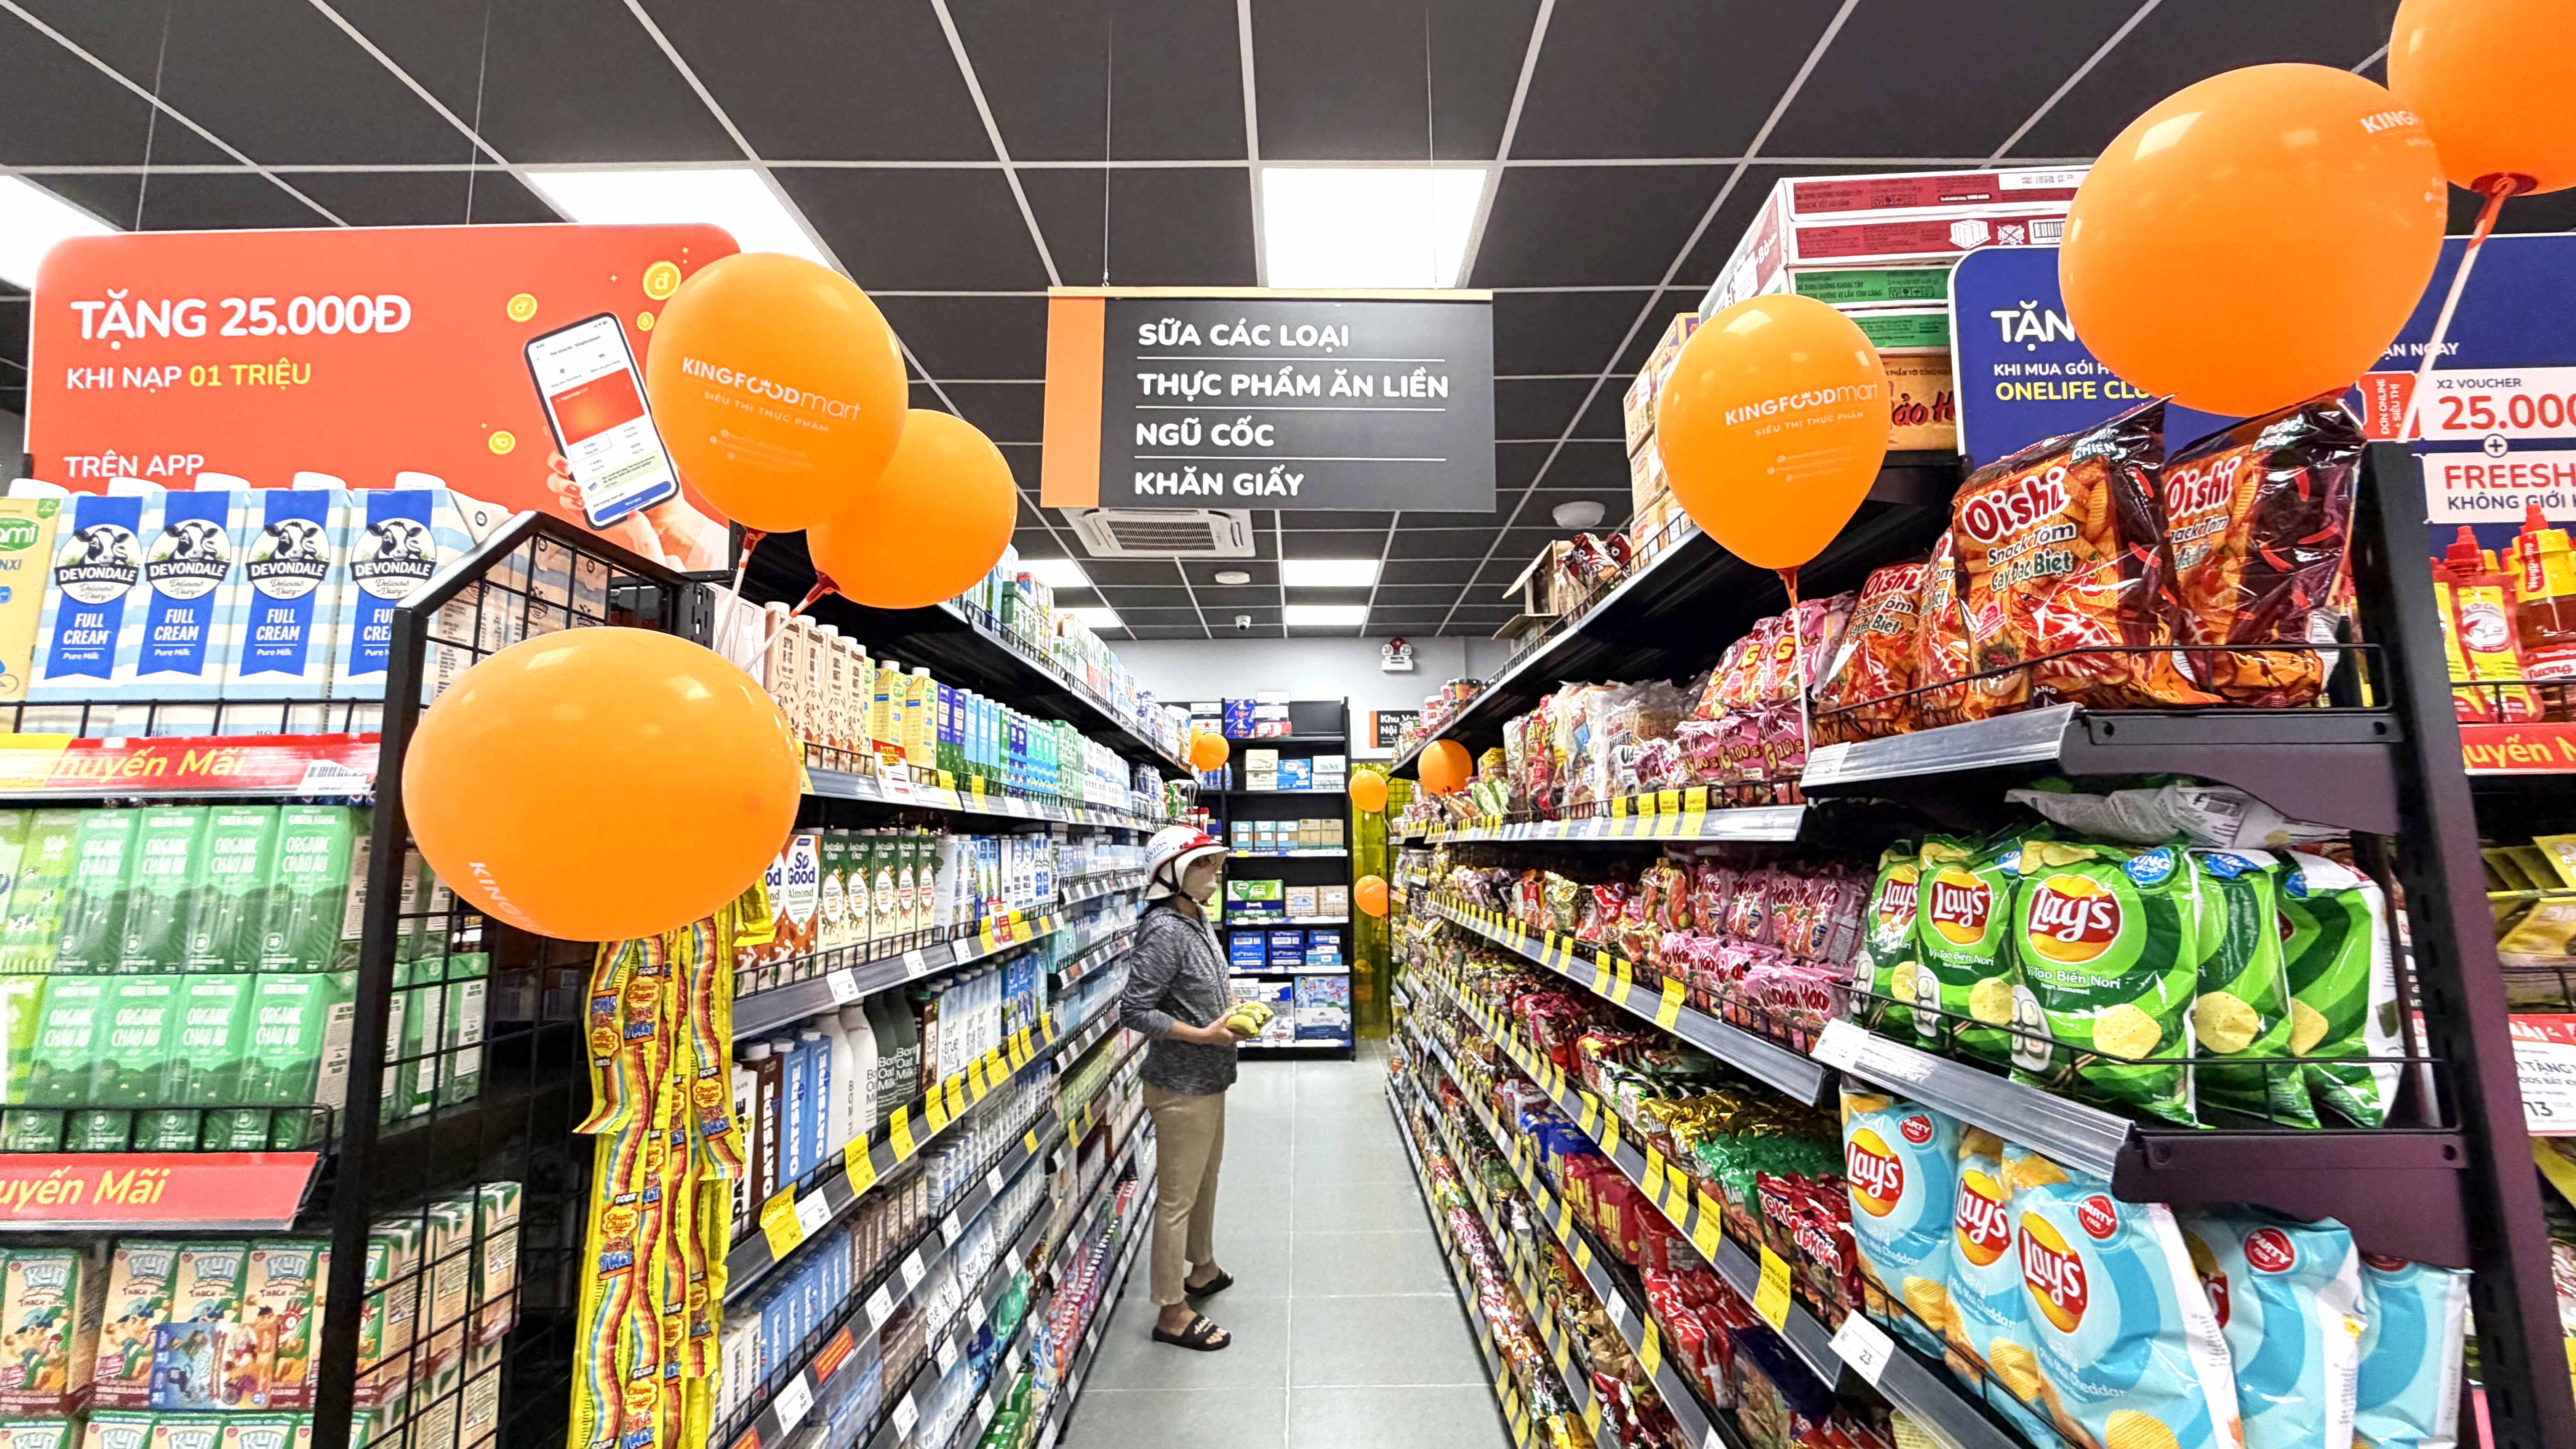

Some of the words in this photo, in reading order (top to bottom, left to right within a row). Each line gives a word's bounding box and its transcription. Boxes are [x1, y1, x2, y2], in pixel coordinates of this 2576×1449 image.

[70, 288, 207, 350] TẶNG
[220, 295, 411, 338] 25.000Đ
[1990, 300, 2076, 351] TẶN
[1138, 317, 1201, 346] SỮA
[1210, 318, 1271, 346] CÁC
[1280, 324, 1349, 353] LOẠI
[66, 368, 113, 390] KHI
[122, 366, 182, 393] NẠP
[189, 364, 222, 386] 01
[230, 357, 311, 390] TRIỆU
[1994, 364, 2021, 376] KHI
[2025, 364, 2062, 376] MUA
[2065, 360, 2093, 375] GÓI
[1137, 370, 1222, 402] THỰC
[1231, 366, 1321, 398] PHẨM
[1329, 368, 1373, 398] ĂN
[1383, 367, 1448, 398] LIỀN
[1996, 381, 2097, 401] ONELIFE
[2436, 380, 2453, 389] X2
[2458, 378, 2522, 388] VOUCHER
[1136, 417, 1201, 445] NGŨ
[1211, 415, 1275, 447] CỐC
[64, 450, 138, 478] TRÊN
[146, 454, 204, 477] APP
[1135, 465, 1224, 495] KHĂN
[1233, 464, 1304, 496] GIẤY
[2164, 455, 2242, 521] Oishi
[1963, 467, 2070, 543] Oishi
[2447, 491, 2519, 510] KHÔNG
[2169, 523, 2203, 543] nack
[1988, 538, 2027, 568] Snack
[59, 568, 138, 582] DEVONDALE
[149, 563, 227, 578] DEVONDALE
[250, 563, 326, 577] DEVONDALE
[355, 562, 432, 576] DEVONDALE
[1991, 570, 2011, 593] Cay
[2033, 549, 2073, 578] Biệt
[74, 613, 104, 628] FULL
[165, 608, 194, 624] FULL
[266, 608, 295, 623] FULL
[63, 630, 109, 645] CREAM
[154, 625, 199, 641] CREAM
[256, 625, 301, 641] CREAM
[1380, 714, 1399, 723] Khu
[1380, 725, 1398, 736] Nội
[53, 746, 168, 784] huyến
[176, 747, 250, 777] Mãi
[795, 852, 809, 869] So
[788, 867, 815, 885] Good
[788, 888, 814, 899] Almond
[1933, 882, 1988, 928] Lay's
[2029, 890, 2114, 943] Lay's
[1973, 955, 1994, 966] Nori
[2057, 968, 2086, 985] Biển
[2090, 975, 2121, 990] Nori
[816, 1052, 827, 1160] OATSIDE
[789, 1064, 802, 1178] OATSIDE
[762, 1081, 775, 1199] OATSIDE
[1847, 1142, 1900, 1198] Lay's
[93, 1168, 171, 1205] Mãi
[1955, 1179, 2008, 1245] Lay's
[2082, 1201, 2115, 1227] PARTY
[2250, 1232, 2292, 1264] PARTY
[2020, 1230, 2081, 1307] Lay's
[1858, 1350, 1872, 1366] 23
[2070, 1371, 2128, 1397] Cheddar
